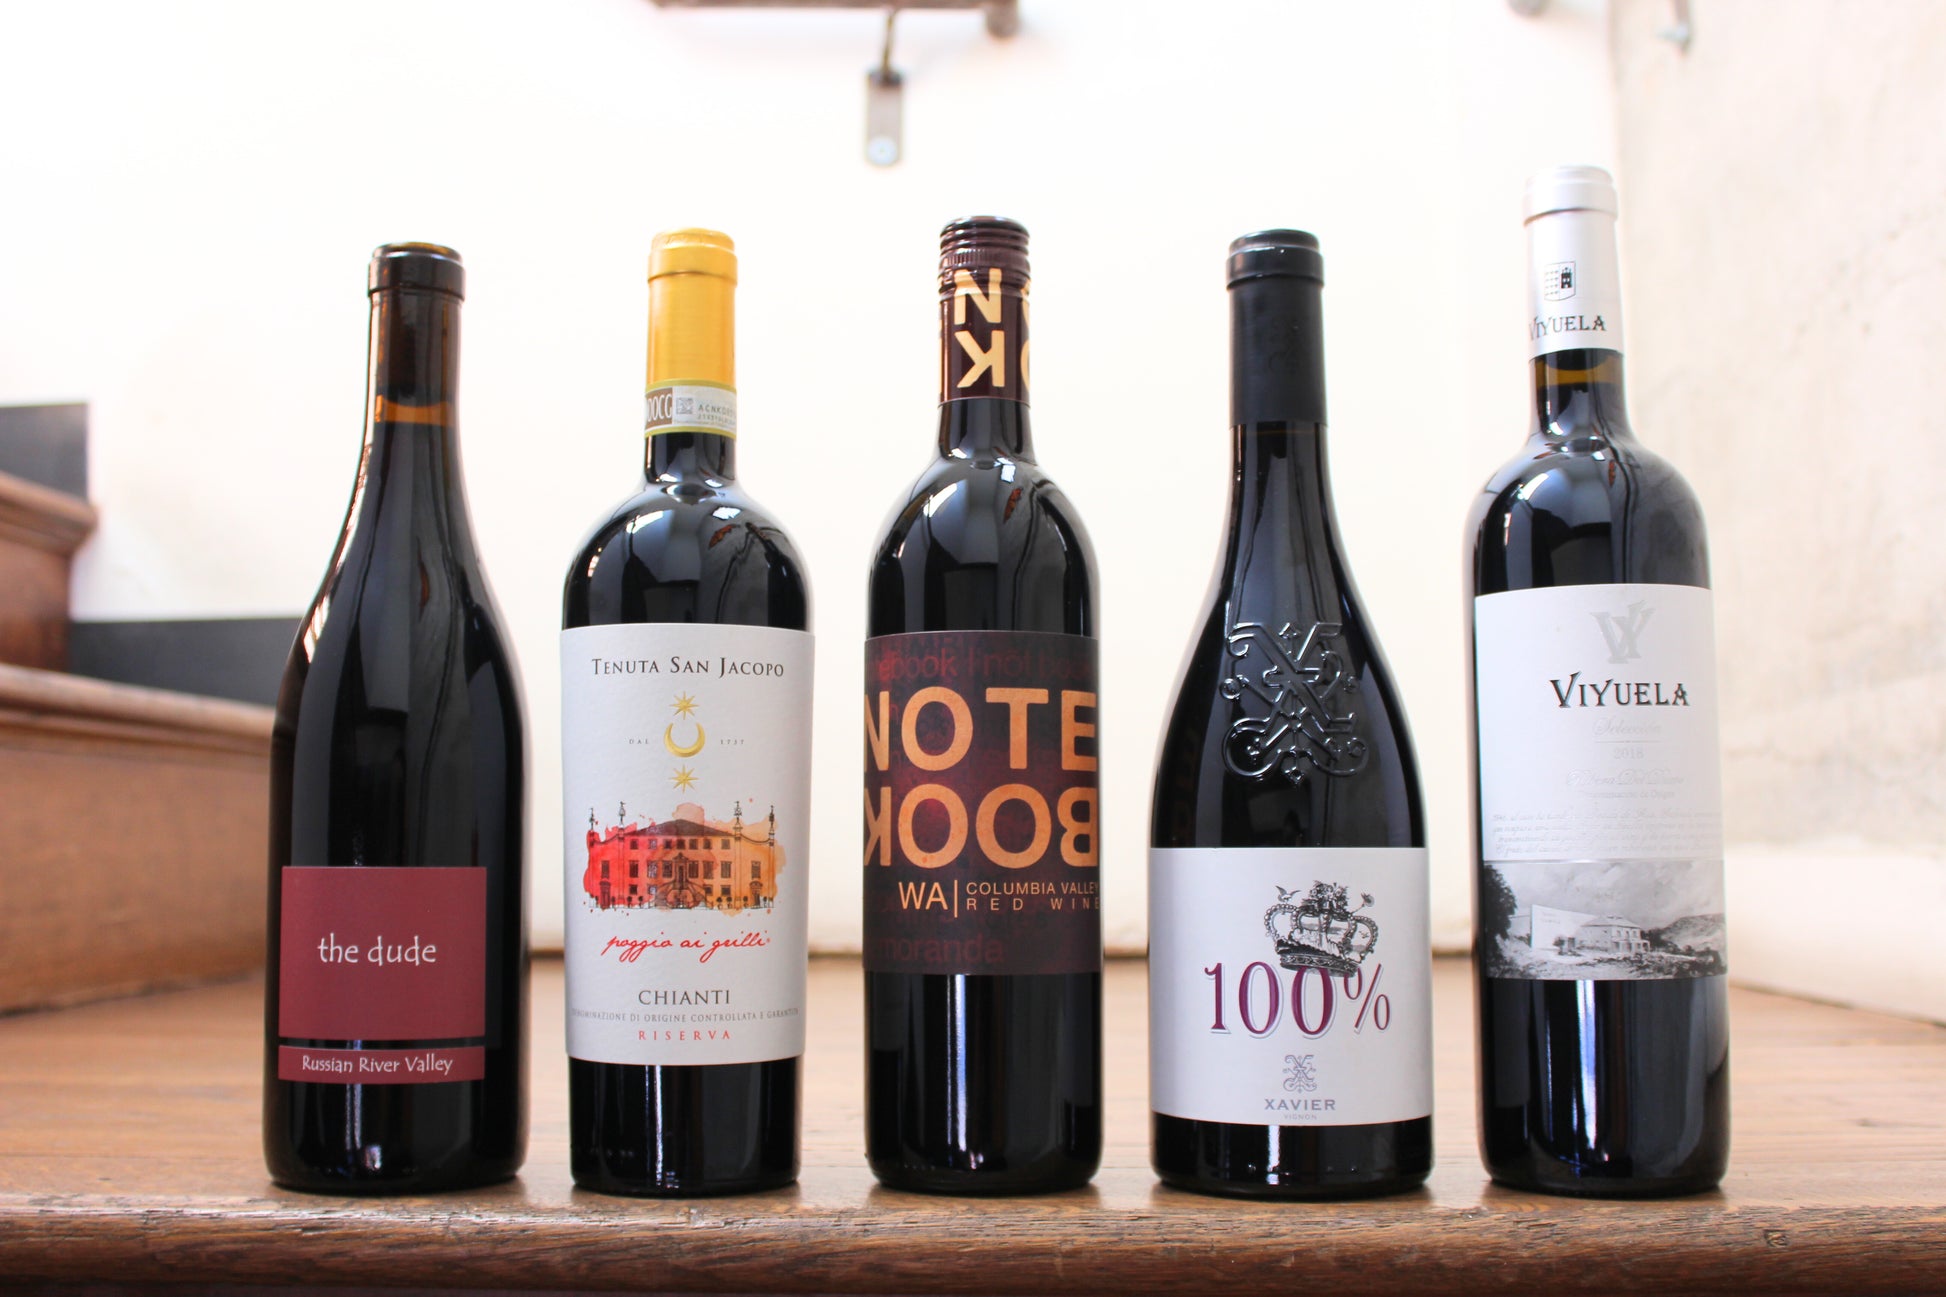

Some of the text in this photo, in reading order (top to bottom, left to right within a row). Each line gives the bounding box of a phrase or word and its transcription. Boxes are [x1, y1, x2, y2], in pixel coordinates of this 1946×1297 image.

[591, 655, 785, 679] TENUTA SAN JACOPO
[1549, 671, 1691, 709] VIYUELA
[864, 685, 1098, 772] NOTE
[898, 881, 949, 911] WA
[966, 881, 1056, 896] COLUMBIA
[966, 897, 1100, 912] RED WINE
[316, 932, 437, 967] the dude
[600, 931, 673, 963] poggio
[680, 931, 707, 948] ai
[638, 989, 730, 1006] CHIANTI
[1204, 960, 1391, 1037] 100%
[630, 1012, 640, 1022] DI
[644, 1013, 687, 1023] ORIGINE
[690, 1012, 757, 1023] CONTROLLATA
[638, 1029, 731, 1042] RISERVA
[302, 1053, 454, 1076] Russian River Valley
[1264, 1098, 1337, 1112] XAVIER
